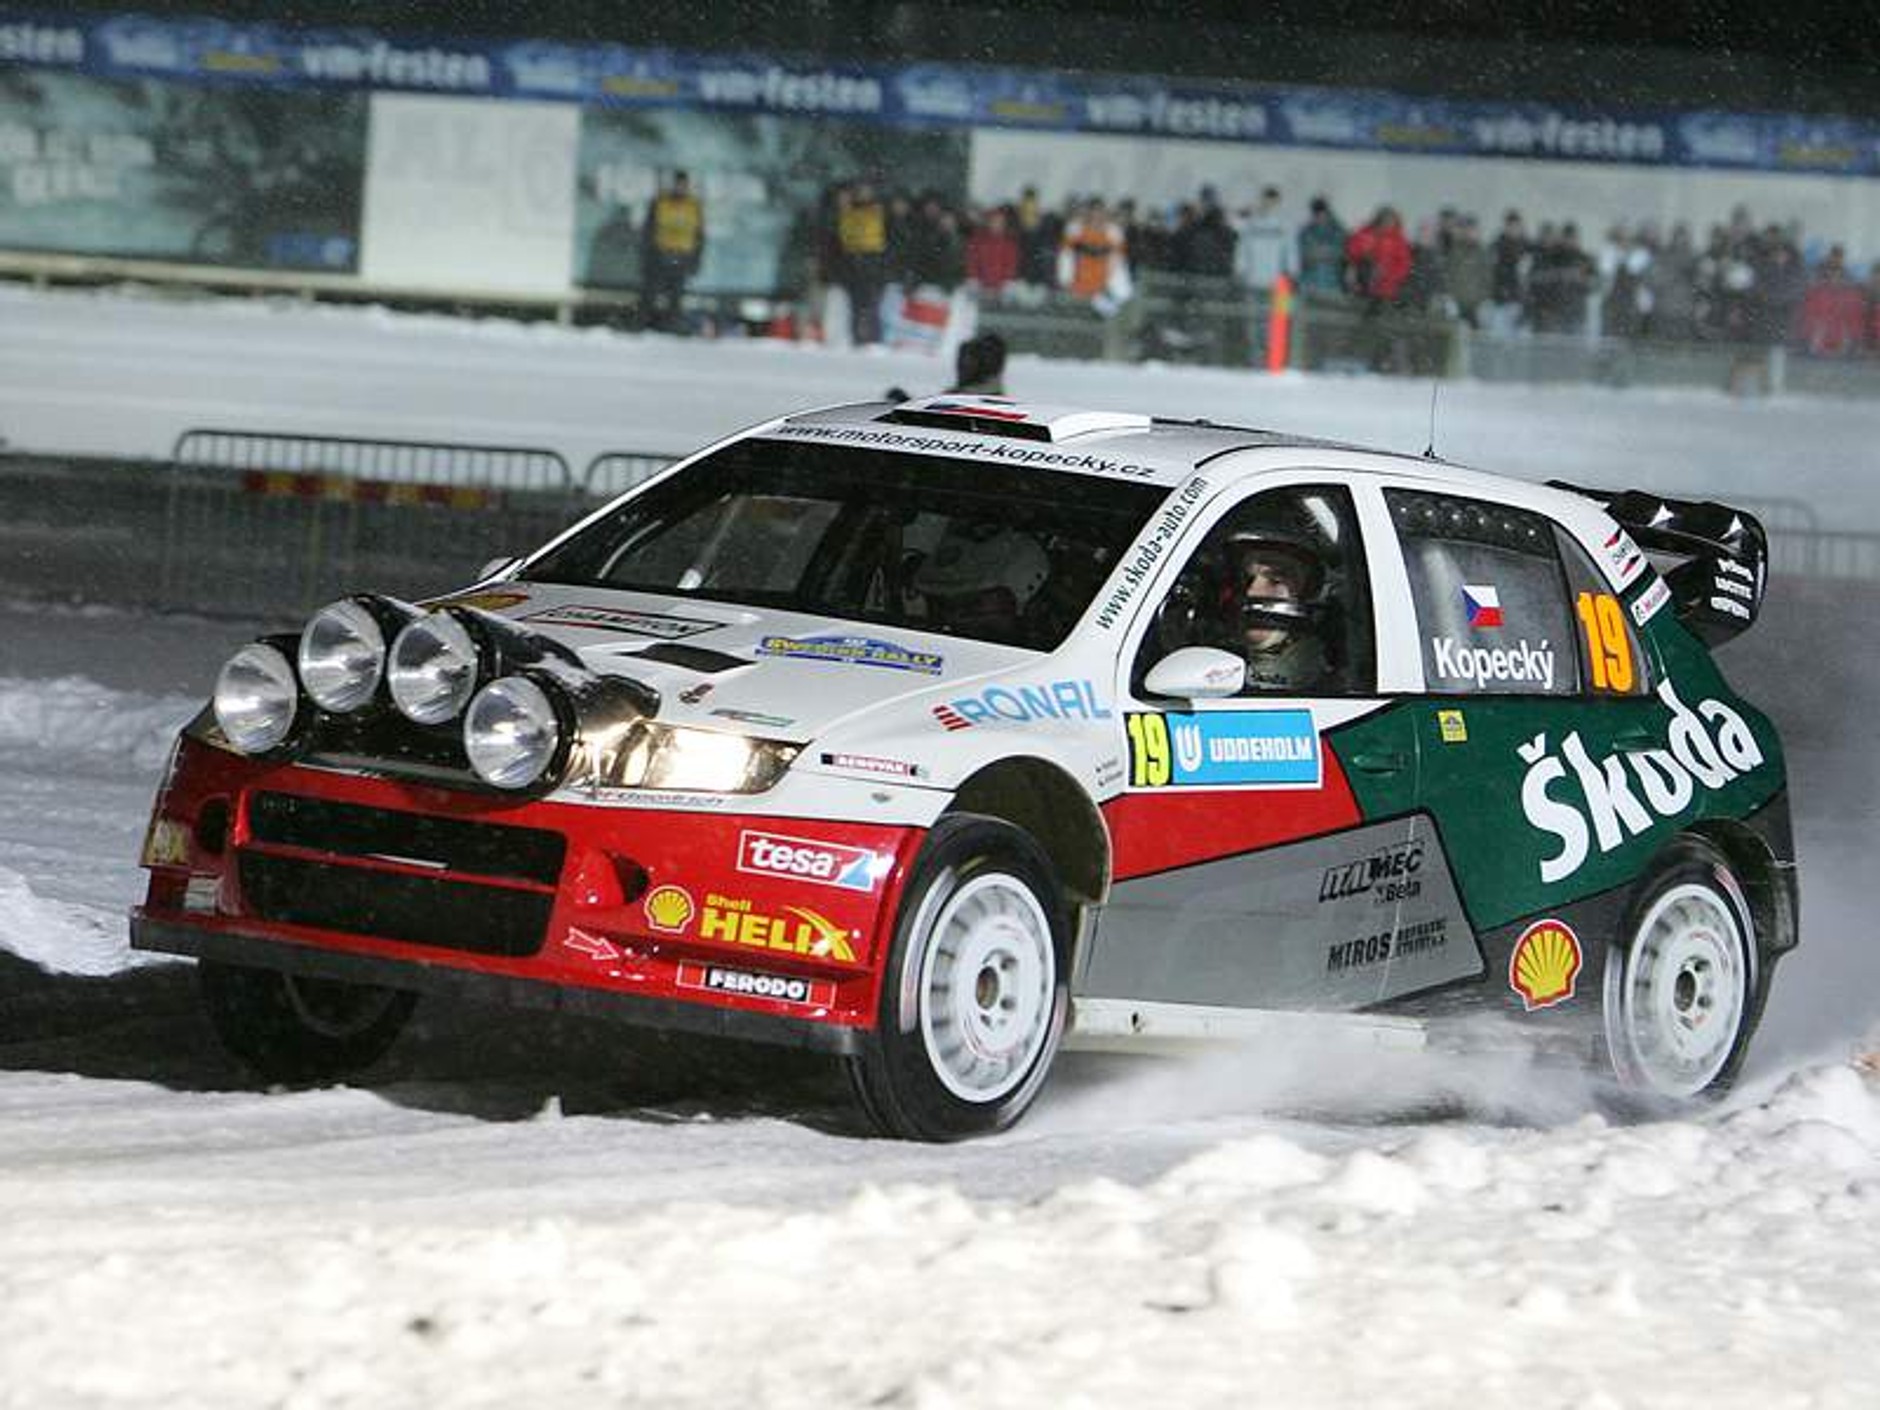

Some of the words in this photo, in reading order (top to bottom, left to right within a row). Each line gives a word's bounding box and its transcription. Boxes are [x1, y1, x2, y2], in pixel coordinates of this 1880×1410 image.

[777, 425, 1156, 478] www.motorsport-kopecky.cz
[1096, 477, 1208, 630] www.skoda-auto.com
[1433, 637, 1555, 690] Kopecký
[1577, 591, 1634, 693] 19
[951, 681, 1112, 722] RONAL
[1128, 713, 1170, 786] 19
[1209, 737, 1313, 763] UDDEHOLM
[1517, 677, 1764, 884] Škoda
[750, 838, 834, 877] tesa
[700, 905, 857, 962] HELIX
[1328, 932, 1392, 971] MIROS
[709, 967, 806, 999] FERODO
